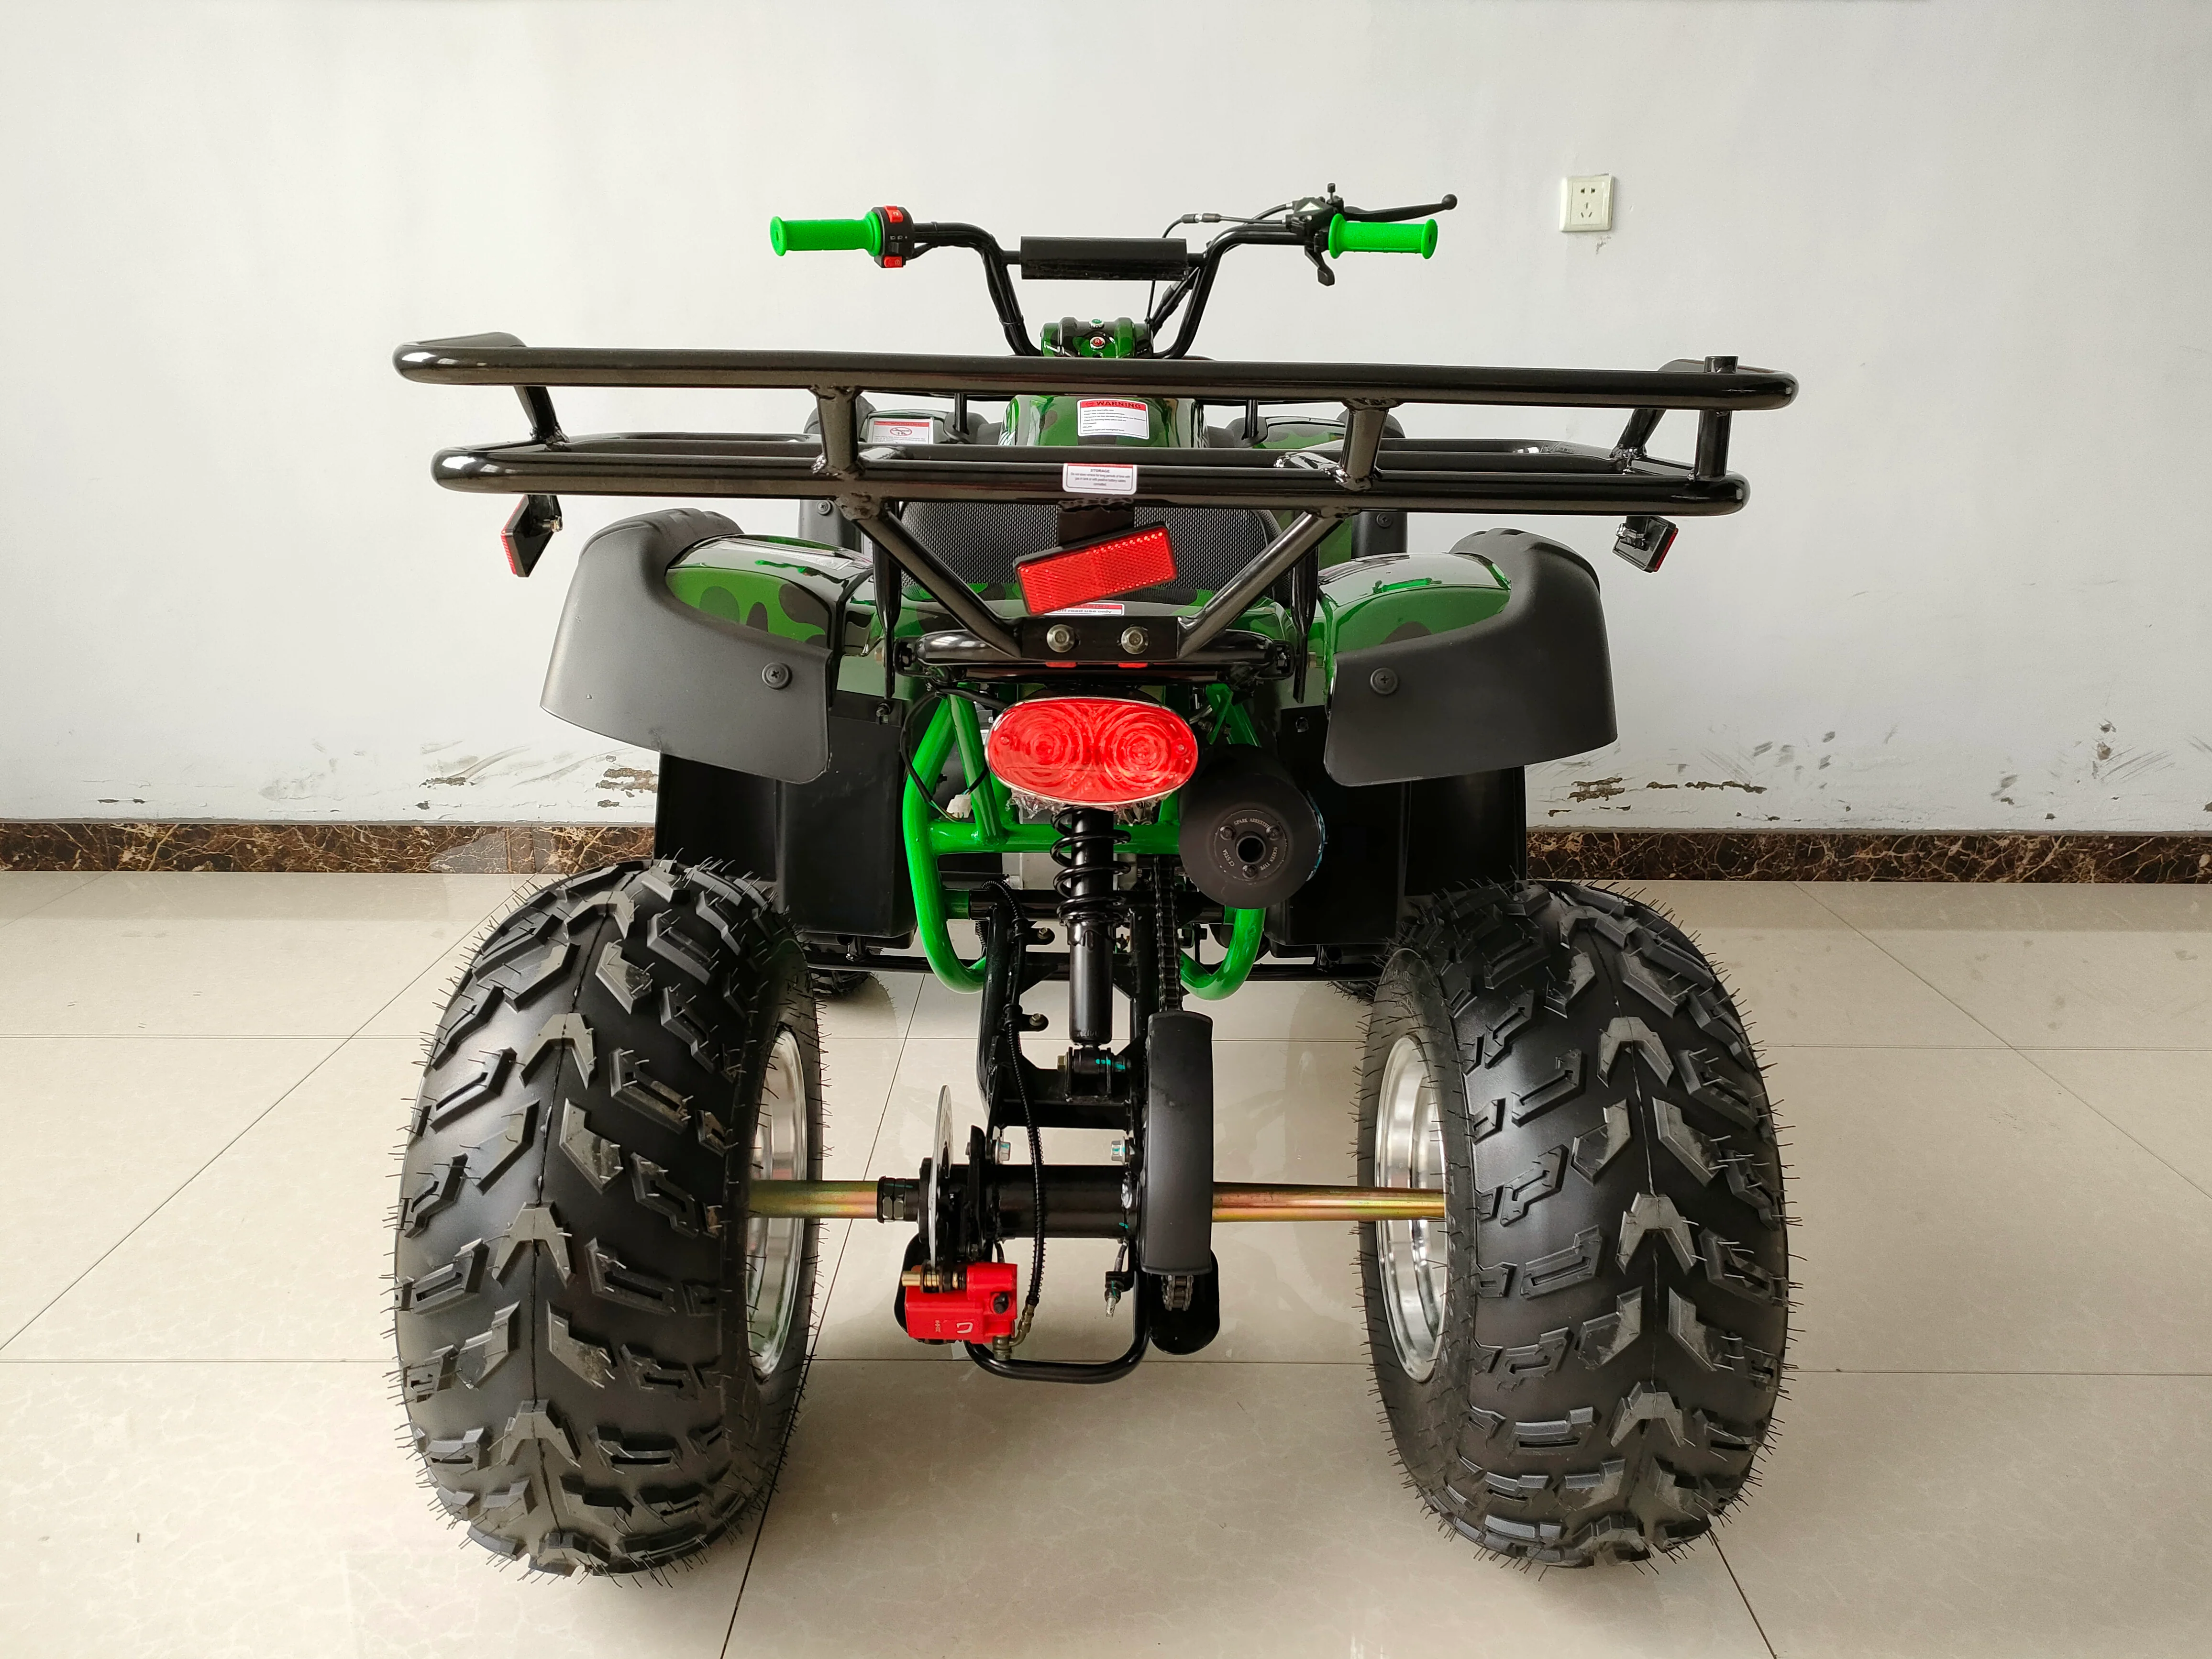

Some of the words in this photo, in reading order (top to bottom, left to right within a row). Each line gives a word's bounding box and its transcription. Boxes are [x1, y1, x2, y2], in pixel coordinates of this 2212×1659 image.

[1096, 401, 1141, 409] WARNING
[1269, 847, 1278, 862] SCREEN
[1259, 862, 1271, 871] TYPE
